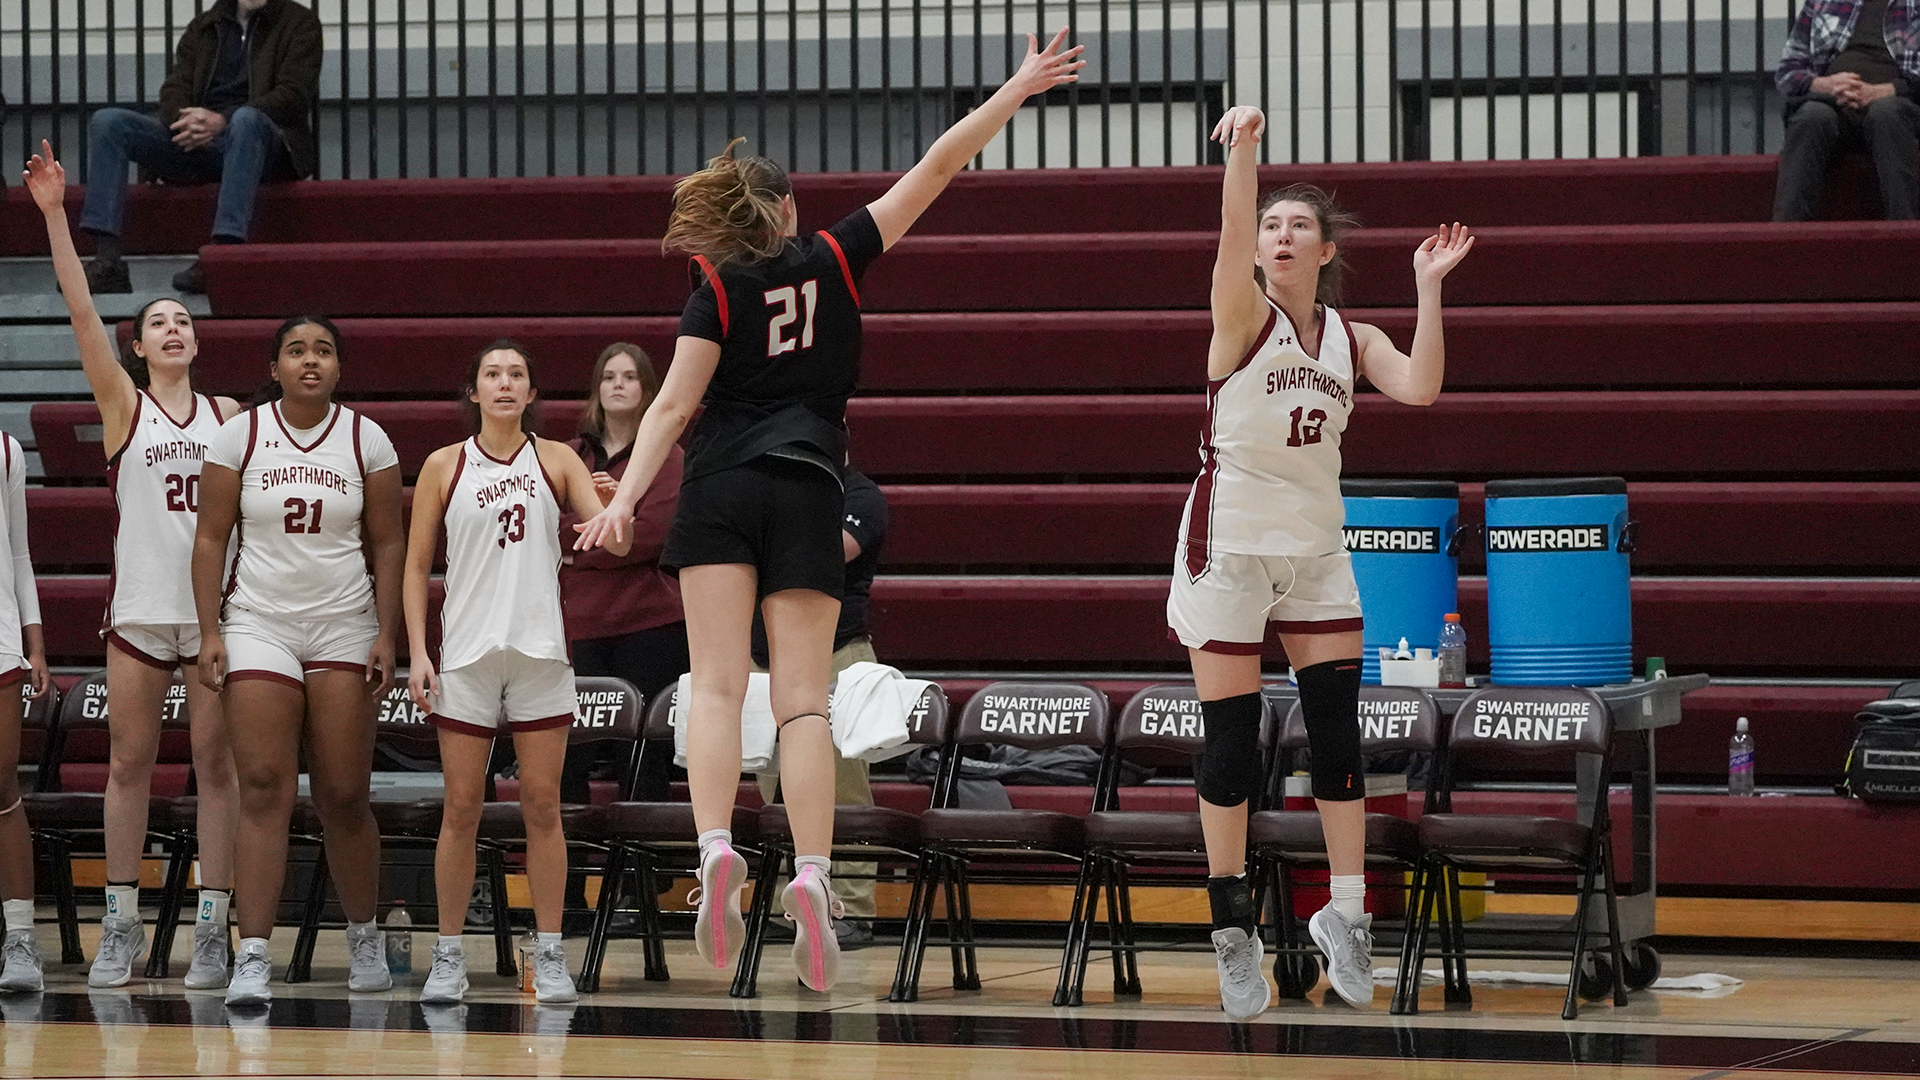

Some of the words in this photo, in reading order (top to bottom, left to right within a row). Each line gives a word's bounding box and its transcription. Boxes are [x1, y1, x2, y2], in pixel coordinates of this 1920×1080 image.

[763, 278, 819, 358] 21
[1286, 405, 1328, 447] 12
[261, 465, 348, 496] SWARTHMORE
[165, 473, 201, 513] 20
[283, 496, 323, 534] 21
[497, 503, 526, 550] 33
[1342, 528, 1434, 551] WERADE
[1489, 527, 1602, 550] POWERADE
[575, 691, 625, 705] HMORE
[983, 695, 1092, 711] SWARTHMORE
[1142, 697, 1203, 714] SWART
[1357, 700, 1420, 715] THMORE
[1475, 699, 1591, 716] SWARTHMORE
[572, 705, 623, 728] NET
[980, 709, 1090, 735] GARNET
[1140, 711, 1206, 738] GAR
[1357, 715, 1418, 739] NET
[1473, 714, 1588, 741] GARNET
[1871, 783, 1920, 793] MUELLE
